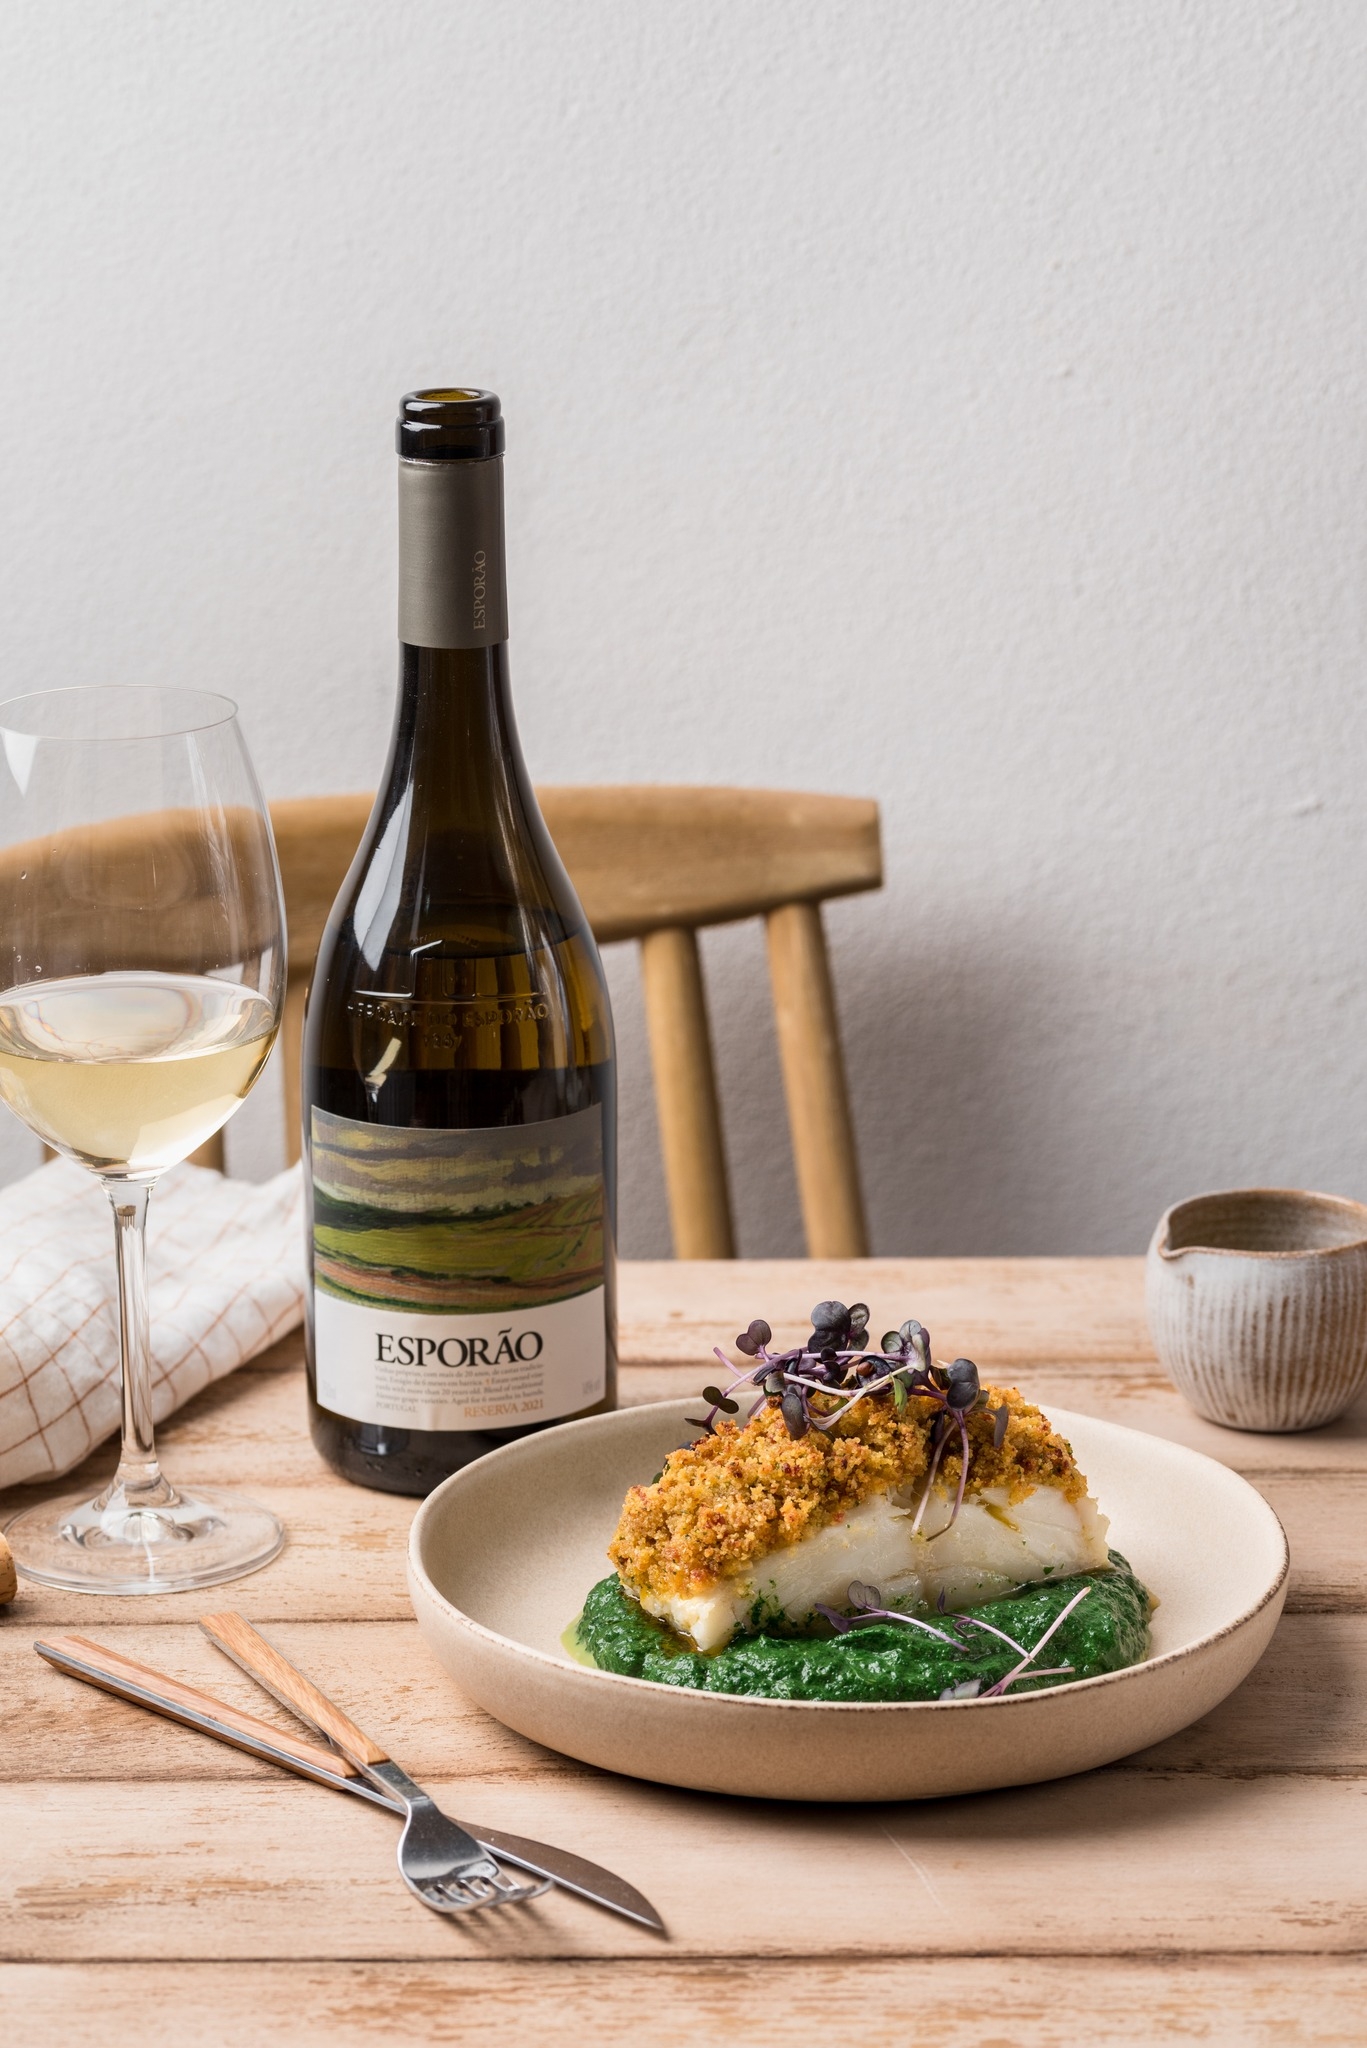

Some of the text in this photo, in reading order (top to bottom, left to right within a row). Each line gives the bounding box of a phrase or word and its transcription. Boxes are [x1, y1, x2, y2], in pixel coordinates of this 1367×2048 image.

[472, 550, 486, 630] ESPORÃO
[375, 1327, 543, 1368] ESPORÃO
[464, 1370, 474, 1378] 20
[441, 1388, 451, 1396] 20
[375, 1401, 418, 1413] PORTUGAL
[464, 1398, 544, 1418] RESERVA 2021
